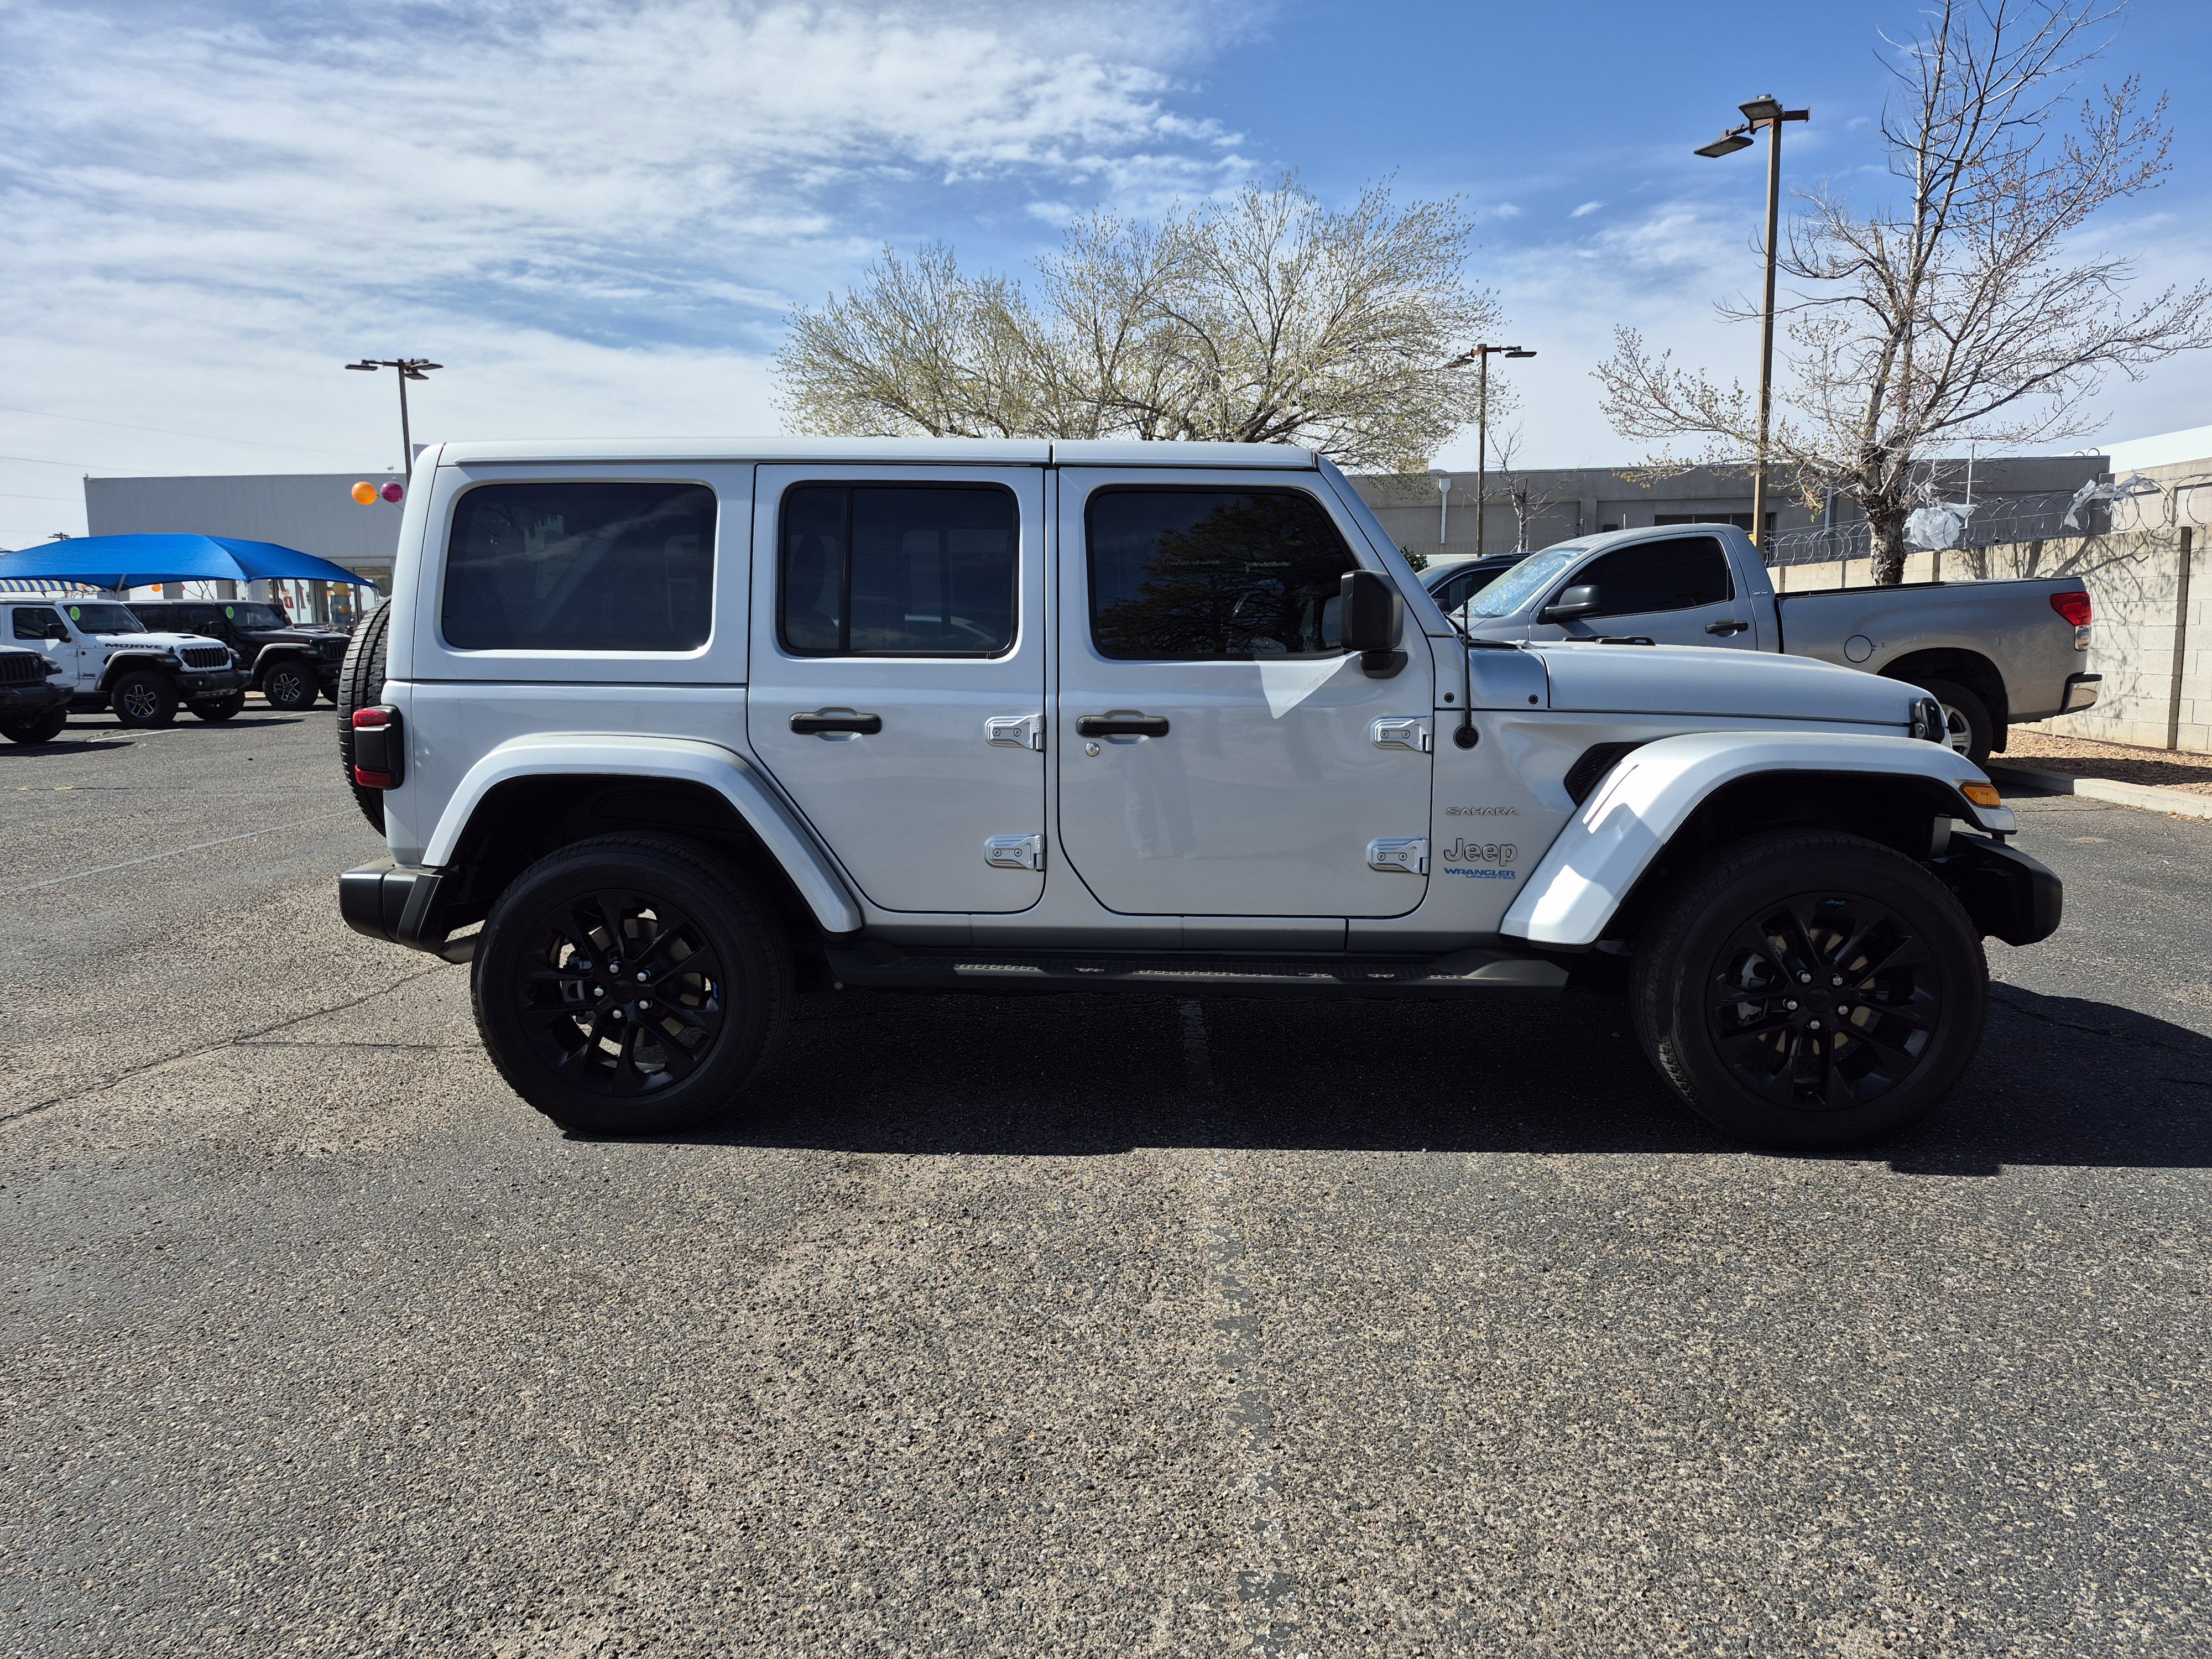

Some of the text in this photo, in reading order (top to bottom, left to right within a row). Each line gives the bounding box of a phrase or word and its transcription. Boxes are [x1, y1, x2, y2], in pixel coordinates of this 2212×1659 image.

[1446, 807, 1519, 816] SAHARA
[1443, 838, 1518, 867] Jeep
[1443, 867, 1516, 877] WRANGLER
